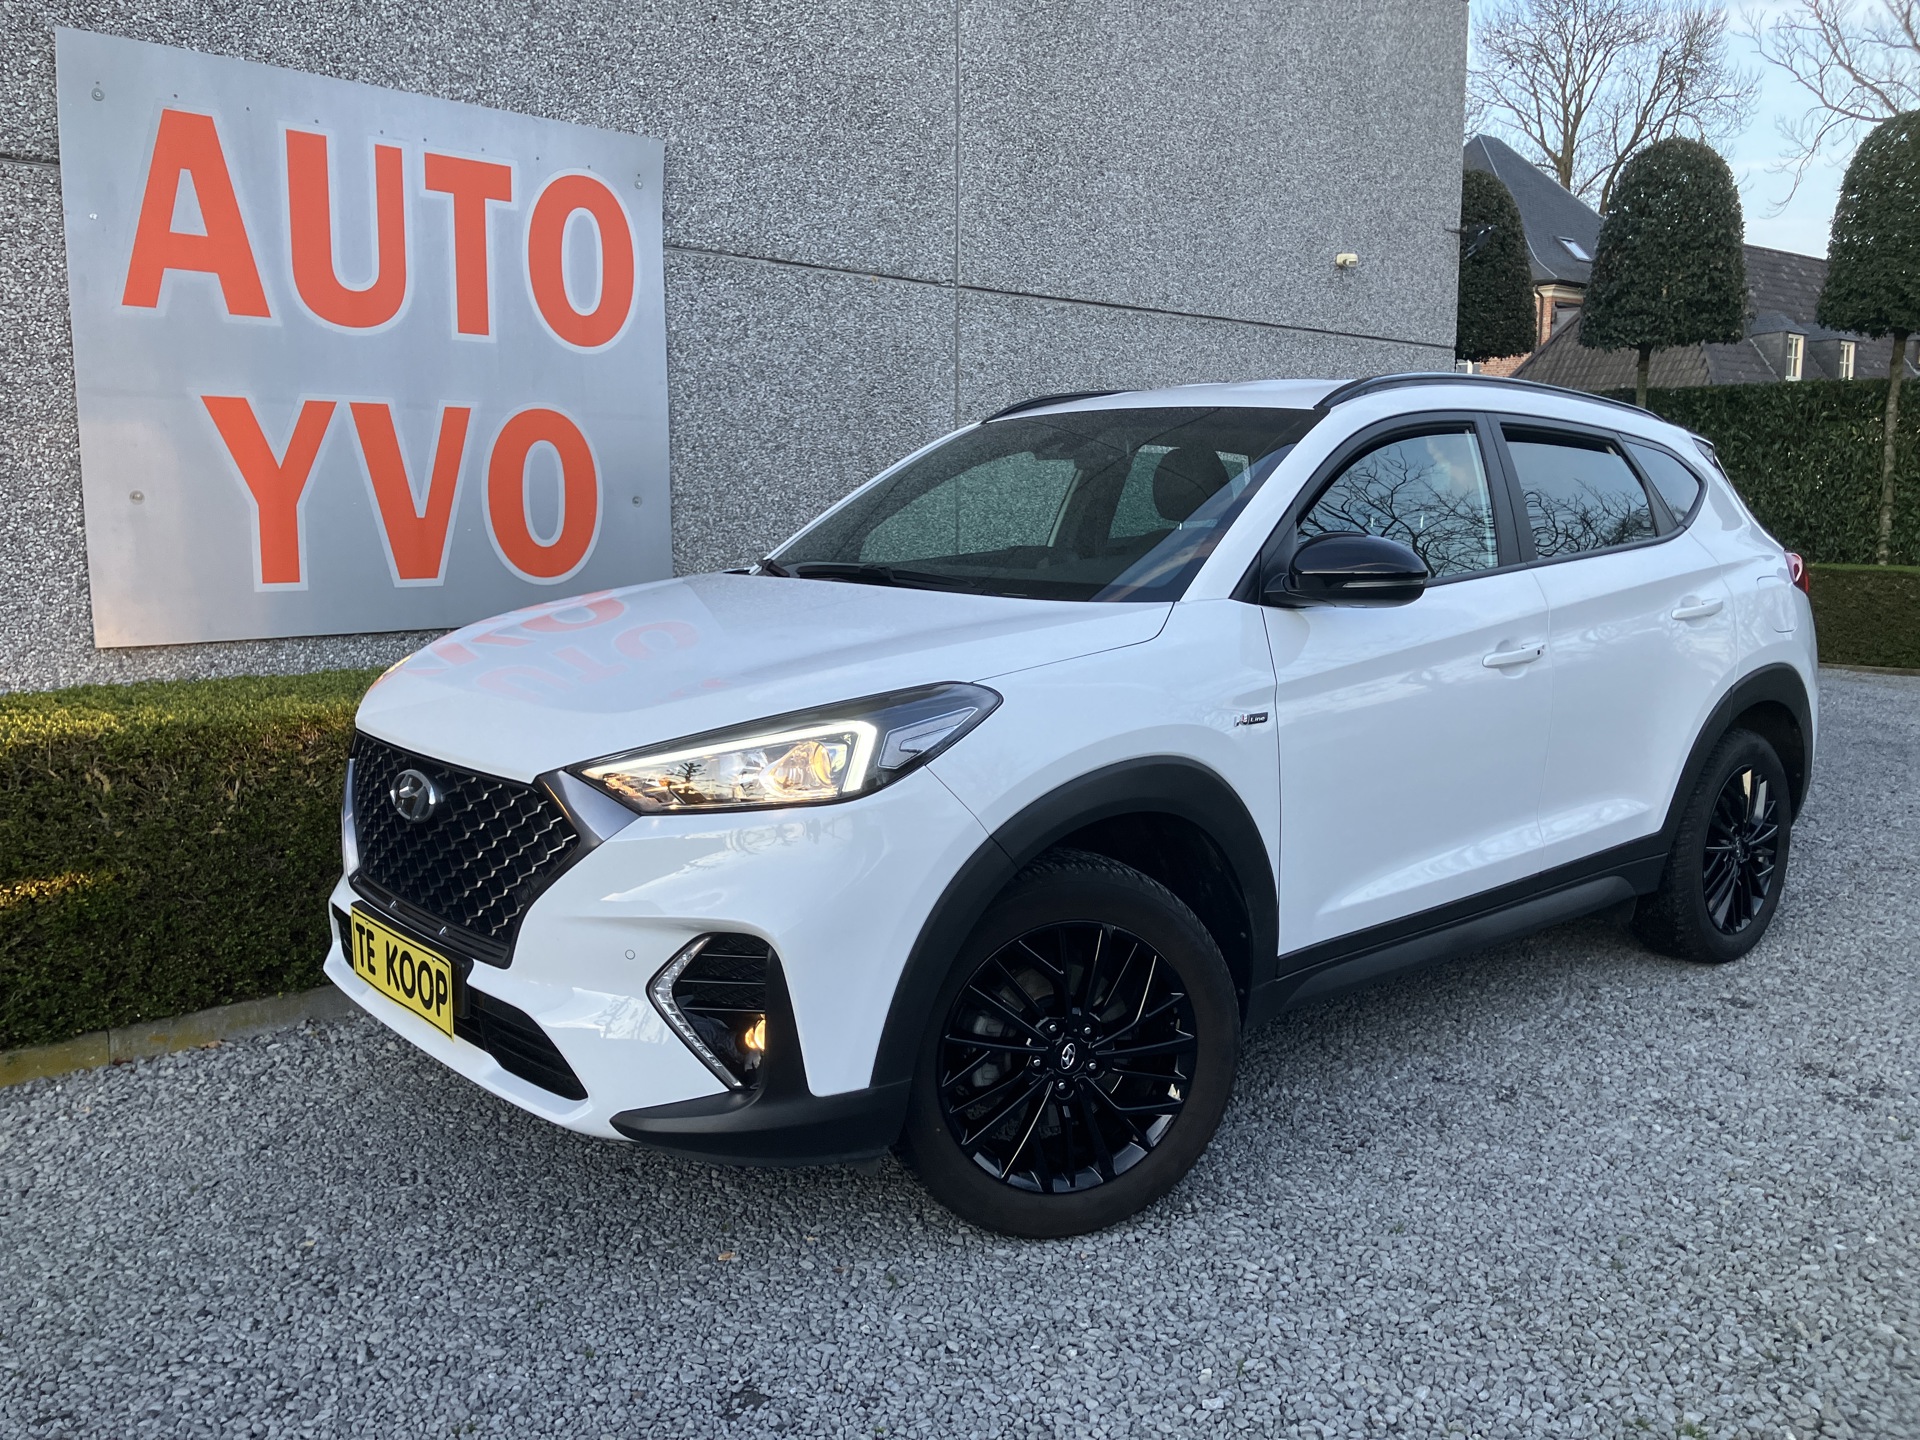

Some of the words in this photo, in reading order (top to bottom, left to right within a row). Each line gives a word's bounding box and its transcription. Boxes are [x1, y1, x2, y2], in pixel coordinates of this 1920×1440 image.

[121, 107, 635, 348] AUTO
[200, 394, 599, 585] YVO
[355, 921, 377, 976] TE
[385, 940, 448, 1018] KOOP
